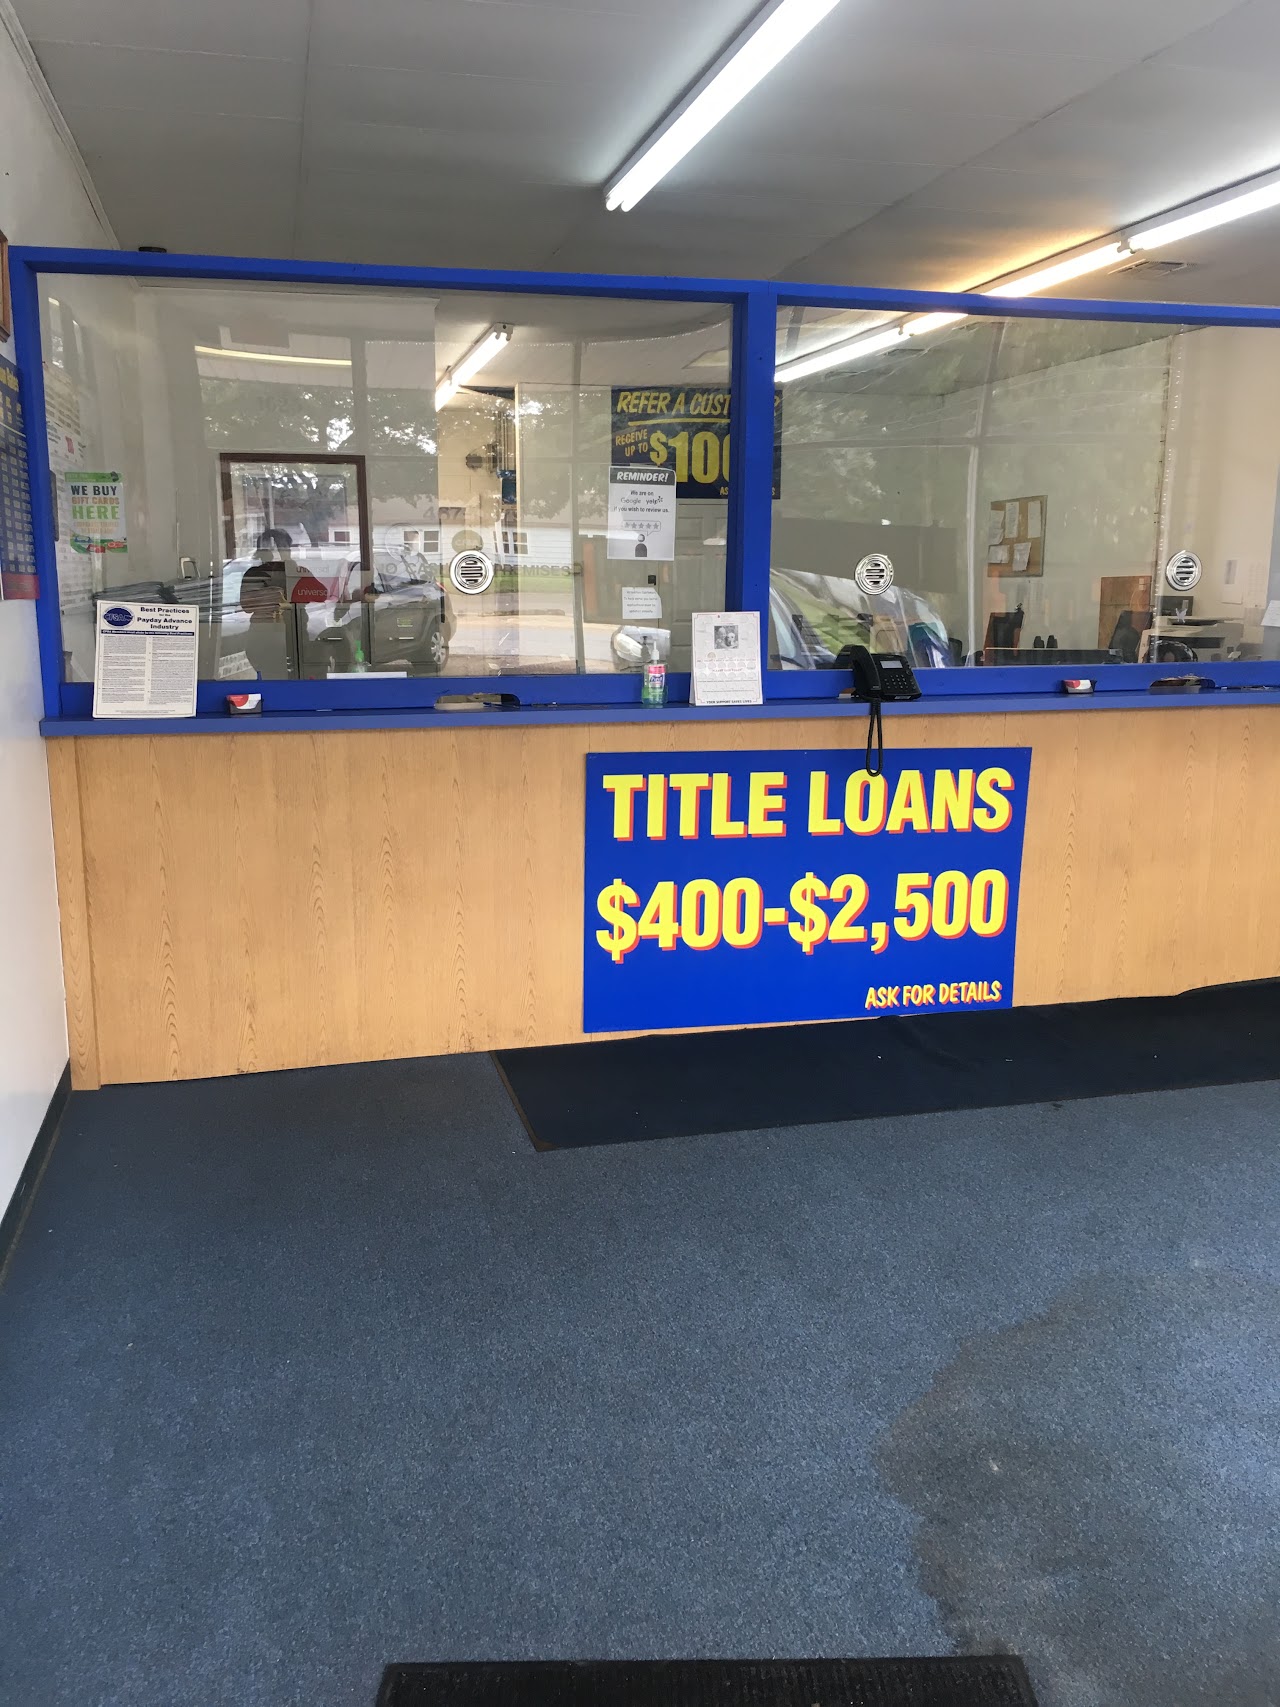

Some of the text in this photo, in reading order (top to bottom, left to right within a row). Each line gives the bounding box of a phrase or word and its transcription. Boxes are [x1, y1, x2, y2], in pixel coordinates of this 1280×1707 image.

[617, 391, 731, 416] REFER A CUST
[615, 429, 648, 446] RECEIVE
[625, 442, 649, 457] UP TO
[649, 430, 730, 484] $10
[616, 471, 669, 483] REMINDER!
[71, 485, 117, 496] WE BUY
[719, 486, 729, 496] AS
[71, 496, 120, 505] GIFT CARDS
[620, 497, 642, 505] Google
[72, 505, 120, 520] HERE
[137, 616, 162, 624] Payday
[150, 623, 179, 631] Industry
[602, 767, 1015, 842] TITLE LOANS
[595, 868, 1010, 964] $400-$2,500
[864, 980, 1003, 1010] ASK FOR DETAILS
